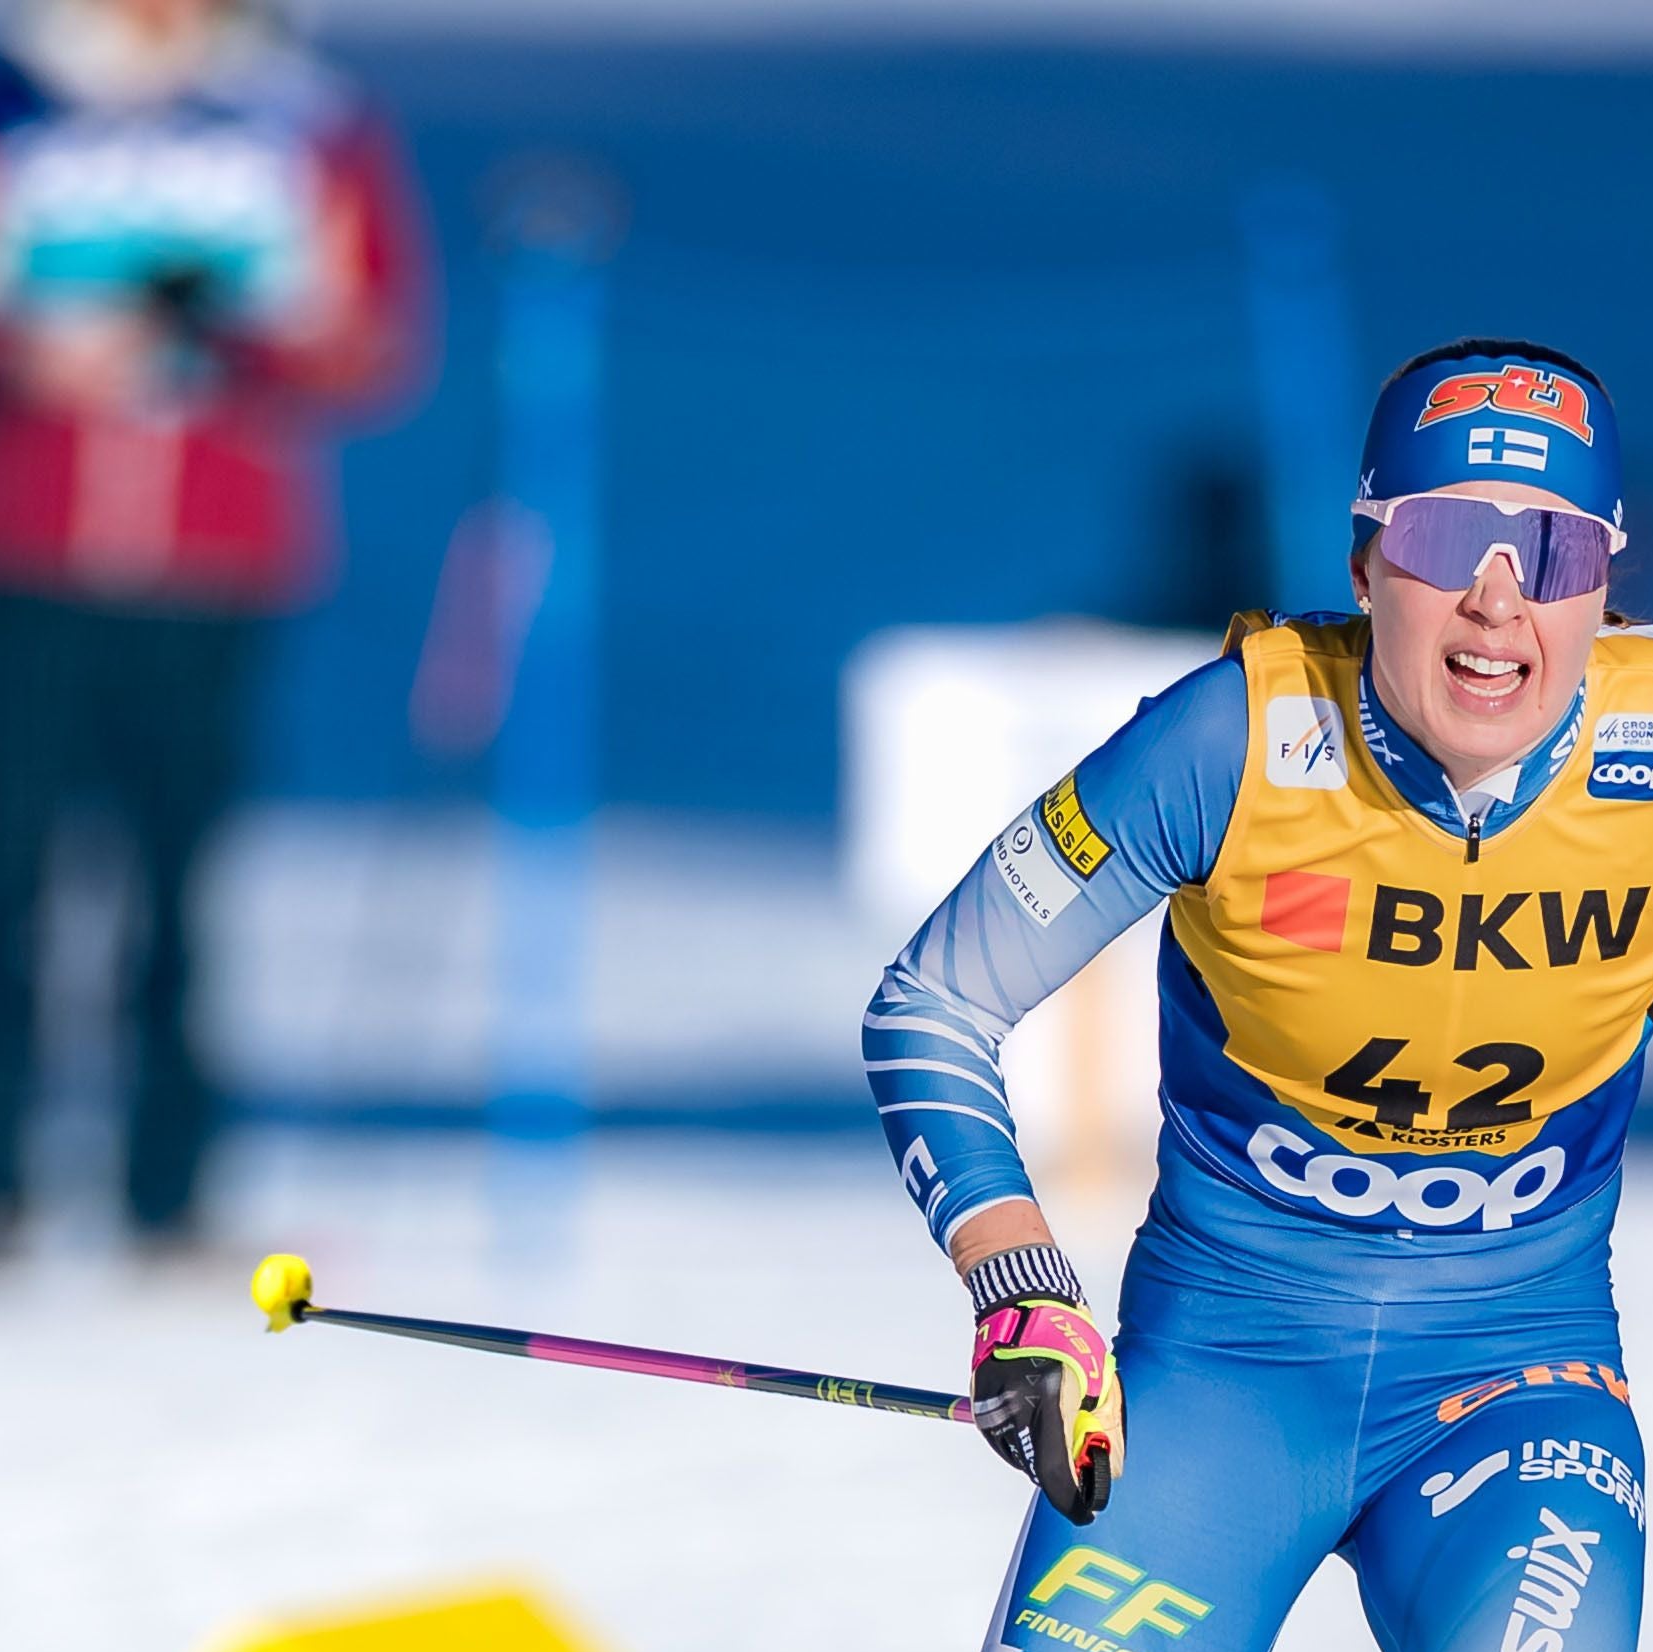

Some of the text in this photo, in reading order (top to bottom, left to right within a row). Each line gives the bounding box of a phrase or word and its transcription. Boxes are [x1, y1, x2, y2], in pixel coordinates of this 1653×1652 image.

[1280, 742, 1336, 761] FIS
[1622, 739, 1651, 747] WORLD
[1004, 862, 1051, 920] HOTELS
[1367, 883, 1652, 972] BKW
[1323, 1037, 1546, 1129] 42
[1390, 1130, 1507, 1148] KLOSTERS
[1247, 1123, 1566, 1231] coop
[1027, 1545, 1215, 1640] FF
